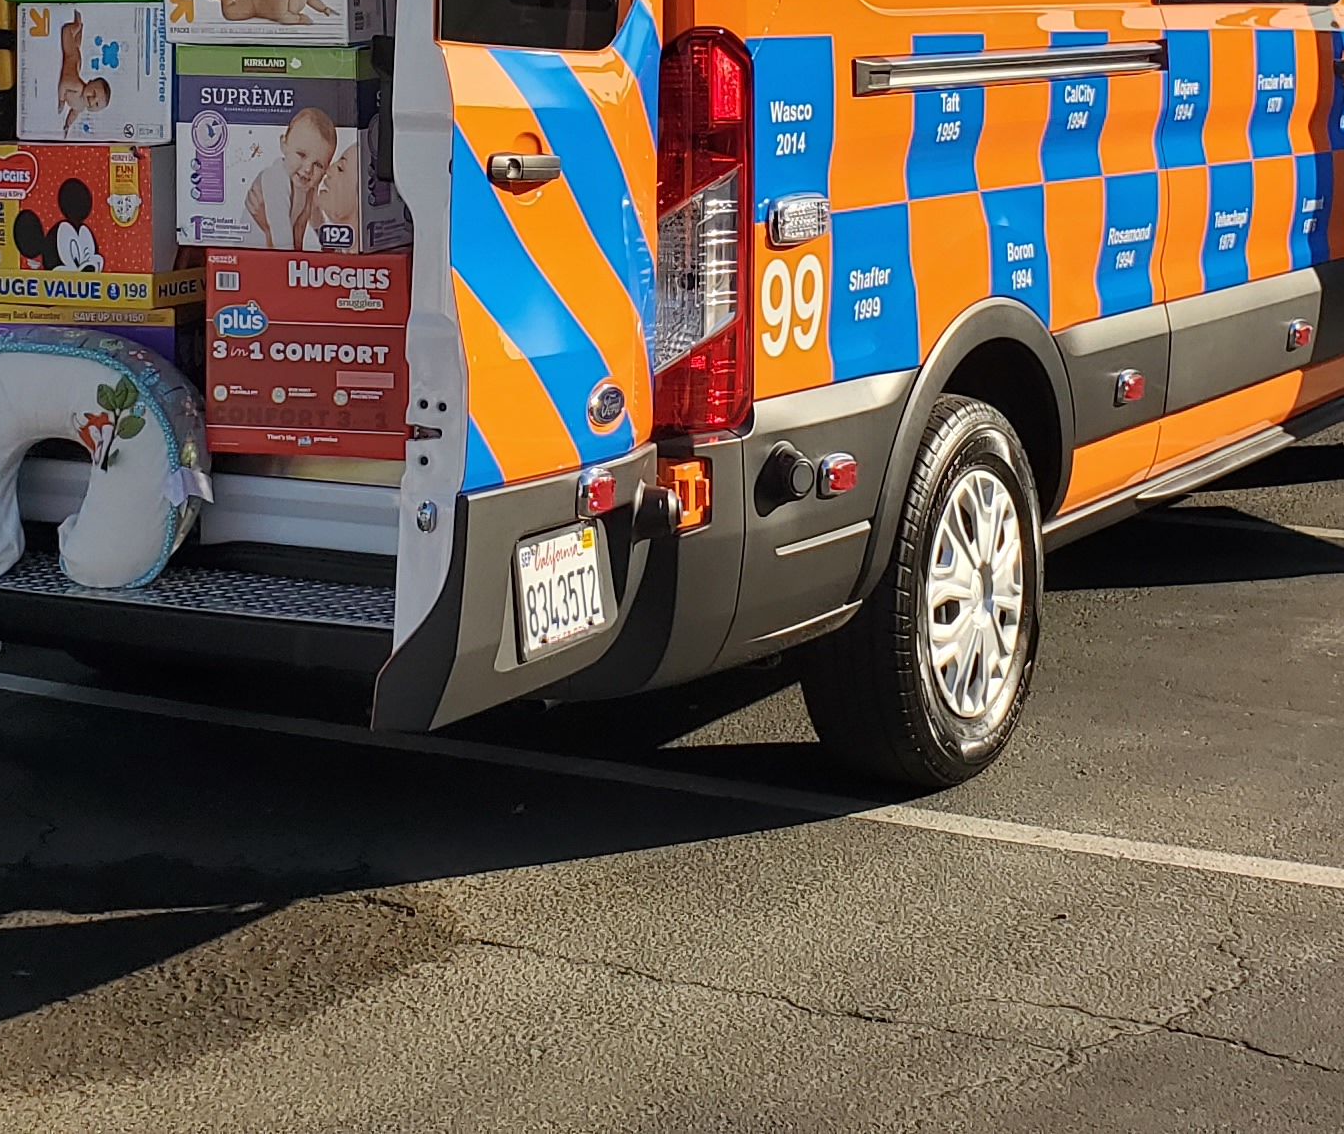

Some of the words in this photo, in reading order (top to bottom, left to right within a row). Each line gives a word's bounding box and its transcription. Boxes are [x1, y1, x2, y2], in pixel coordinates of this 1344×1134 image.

[244, 58, 286, 68] KIRKLAND
[1173, 78, 1199, 101] Mojave
[1279, 72, 1295, 90] Park
[201, 85, 294, 106] SUPRÊME
[940, 93, 960, 114] Taft
[1064, 84, 1096, 107] CalCity
[770, 100, 812, 123] Wasco
[1067, 111, 1089, 131] 1994
[935, 121, 960, 143] 1995
[776, 132, 806, 156] 2014
[116, 165, 134, 173] FUN
[191, 216, 203, 241] 1
[322, 226, 352, 244] 192
[1108, 223, 1152, 246] Rosamond
[1007, 241, 1034, 263] Boron
[288, 261, 391, 290] HUGGIES
[848, 266, 891, 292] Shafter
[1011, 268, 1033, 291] 1994
[44, 279, 102, 299] VALUE
[123, 283, 147, 298] 198
[159, 279, 197, 298] HUGE
[338, 298, 383, 310] snugglers
[761, 254, 824, 358] 99
[853, 296, 881, 321] 1999
[74, 312, 97, 322] SAVE
[97, 313, 110, 322] UP
[111, 313, 122, 322] TO
[219, 308, 264, 335] plus
[213, 340, 228, 358] 3
[230, 344, 248, 357] in
[249, 341, 264, 360] 1
[269, 342, 390, 364] COMFORT
[534, 540, 584, 574] California
[527, 564, 600, 638] 83435T2
